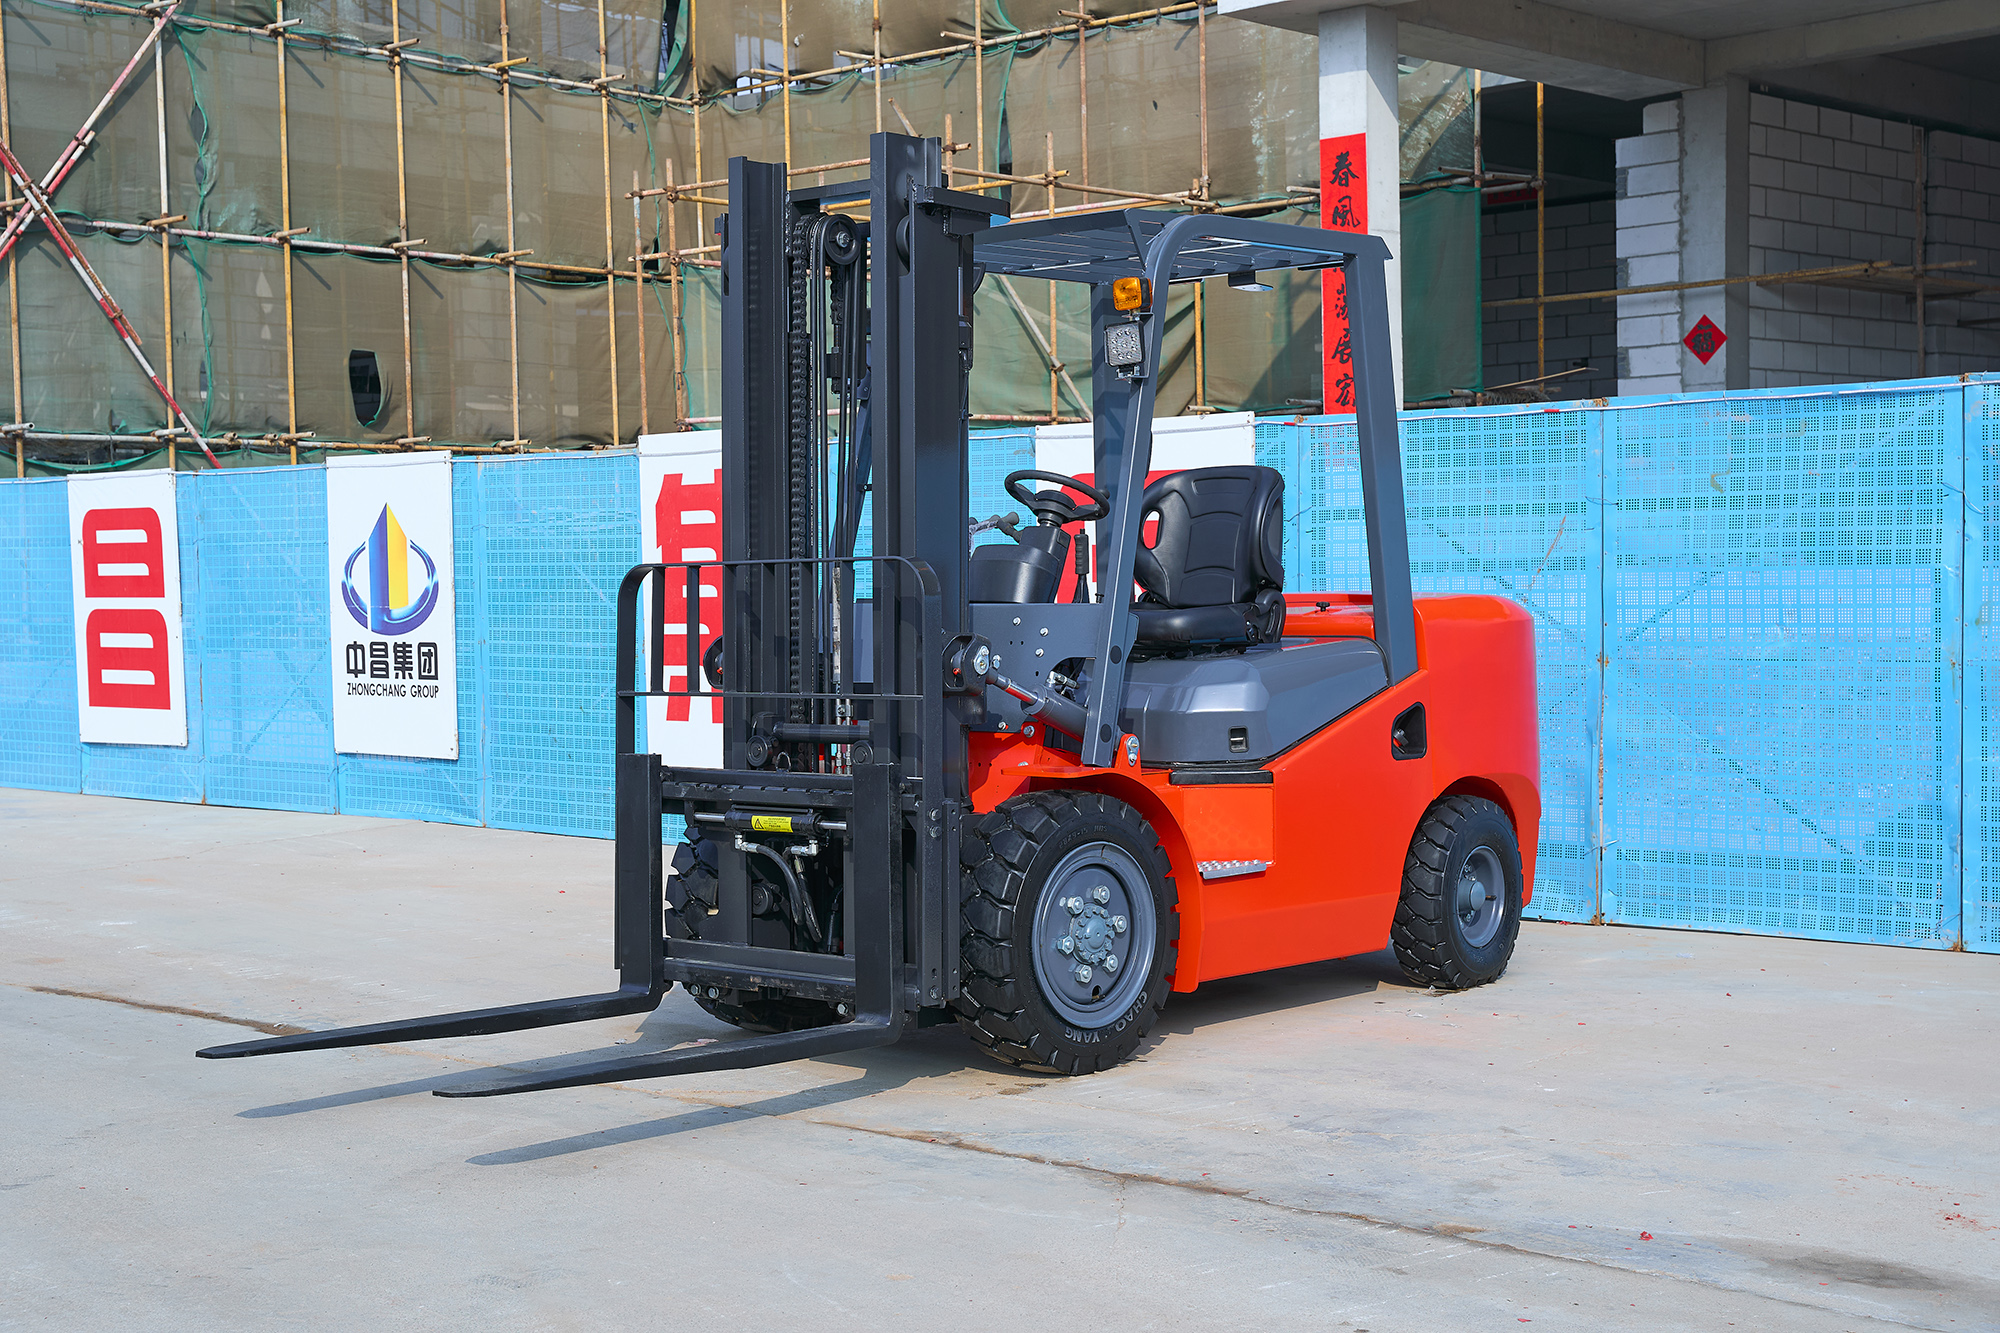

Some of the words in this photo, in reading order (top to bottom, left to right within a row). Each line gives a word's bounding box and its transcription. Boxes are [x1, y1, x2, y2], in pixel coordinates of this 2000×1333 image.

[82, 507, 171, 710] 昌
[346, 641, 438, 680] 中昌集团
[347, 683, 406, 697] ZHONGCHANG
[410, 685, 439, 698] GROUP
[1114, 990, 1148, 1032] CHAO
[1064, 1026, 1100, 1044] YANG
